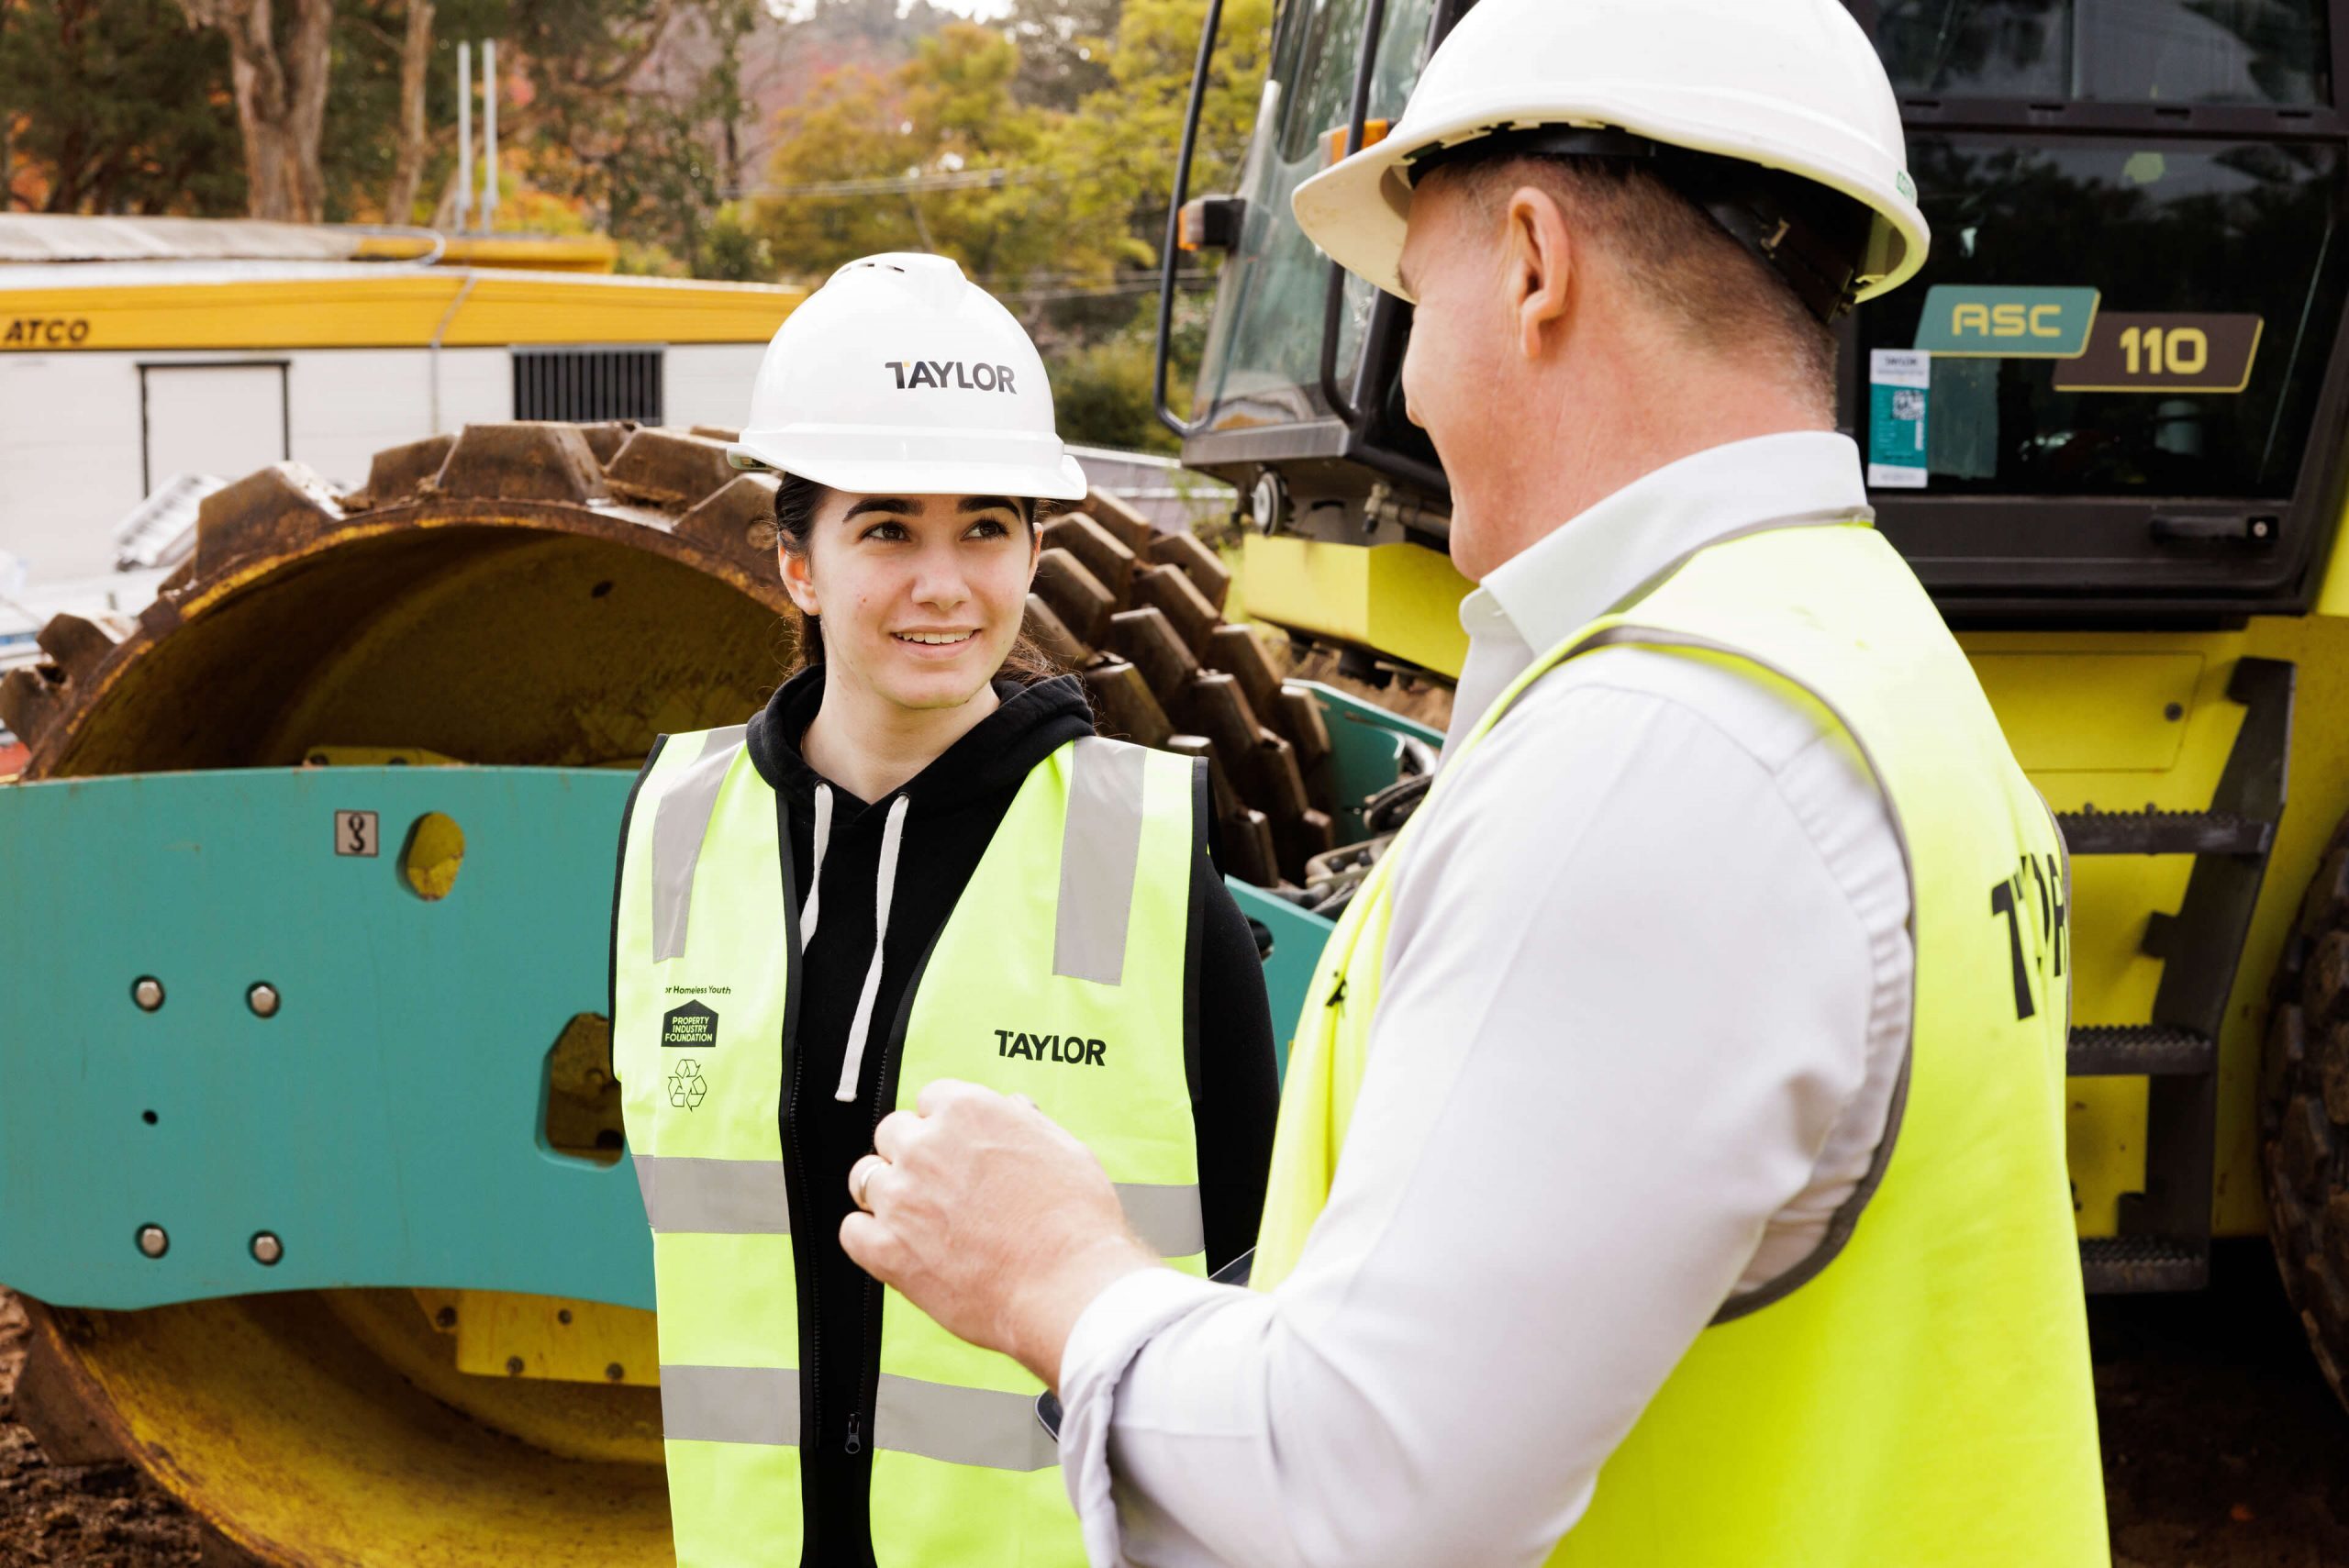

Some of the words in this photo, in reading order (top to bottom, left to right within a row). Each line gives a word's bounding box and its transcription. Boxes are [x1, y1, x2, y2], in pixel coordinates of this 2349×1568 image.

[5, 319, 90, 341] ATCO
[1952, 304, 2061, 337] ASC
[2120, 327, 2208, 374] 110
[885, 361, 1017, 395] TAYLOR
[674, 985, 707, 995] Homeless
[708, 985, 731, 995] Youth
[665, 1033, 713, 1042] FOUNDATION
[673, 1025, 707, 1033] INDUSTRY
[995, 1029, 1107, 1066] TAYLOR
